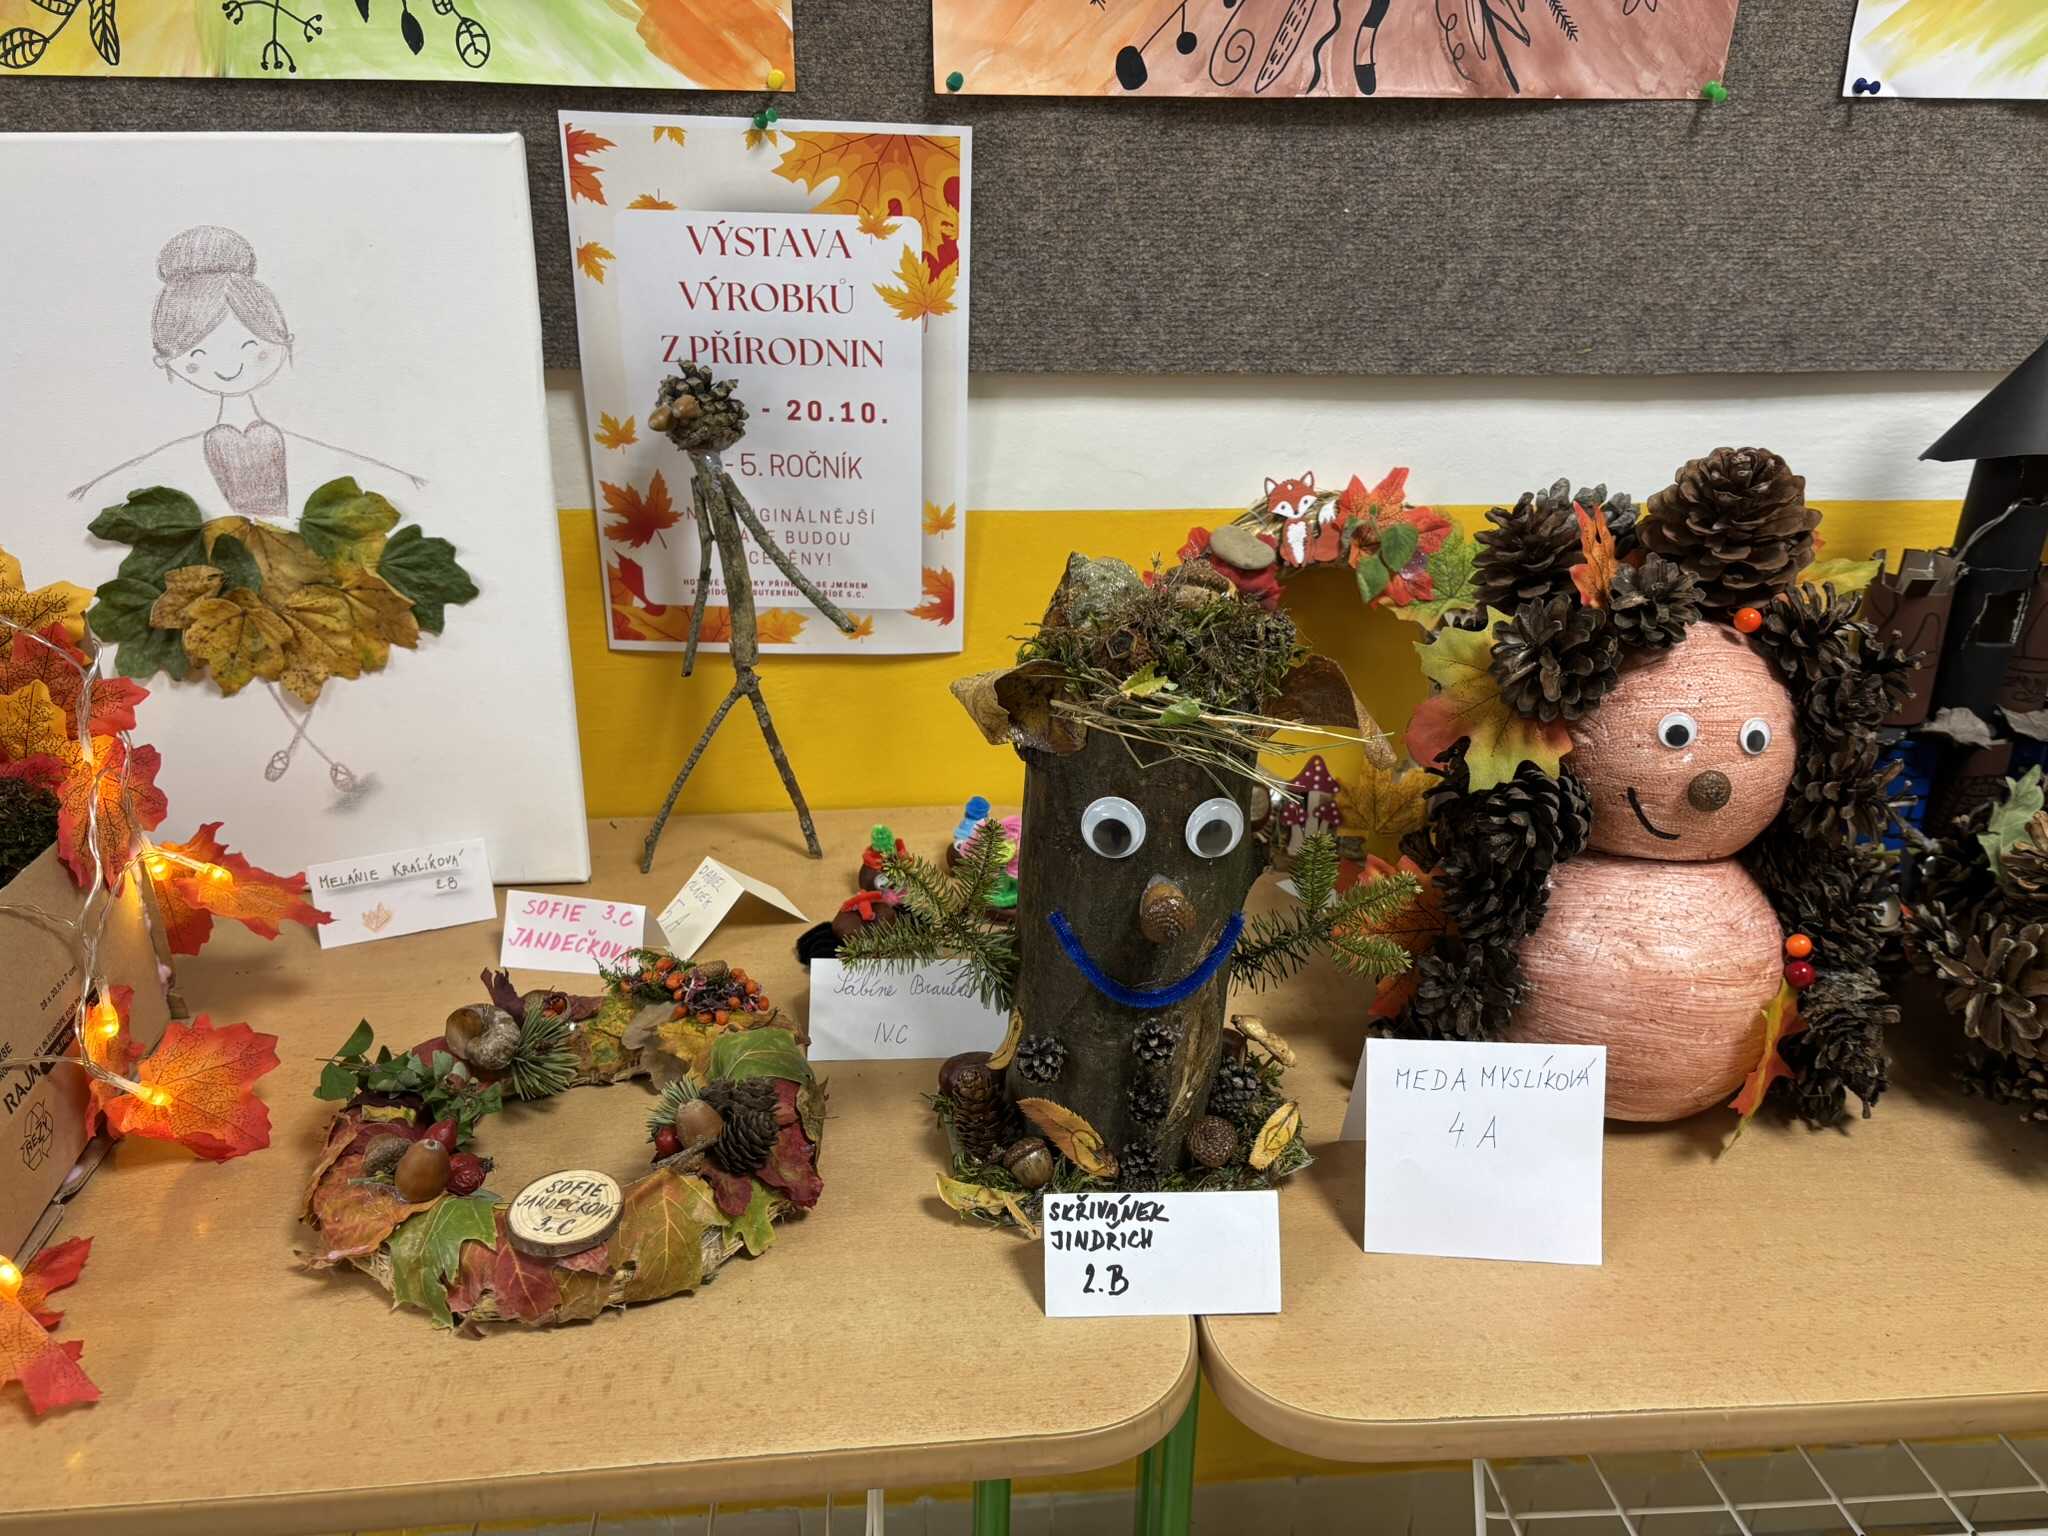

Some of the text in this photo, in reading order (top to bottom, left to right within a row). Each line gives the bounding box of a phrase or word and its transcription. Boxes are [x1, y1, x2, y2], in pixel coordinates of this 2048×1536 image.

[686, 220, 852, 259] VÝSTAVA
[678, 276, 854, 314] VÝROBKŮ
[661, 330, 884, 368] Z PŘÍRODNIN
[786, 399, 888, 424] 20.10.
[740, 453, 763, 477] 5.
[770, 451, 863, 479] ROČNÍK
[785, 530, 850, 546] BUDOU
[831, 580, 868, 589] JMÉNEM
[522, 899, 634, 928] SOFIE 3.C
[1395, 1055, 1597, 1092] MEDA MYSLÍKOVÁ
[3, 1063, 41, 1115] RAJA
[545, 1179, 608, 1197] SOFIE
[1049, 1194, 1170, 1223] SKŘIVÁNEK
[1051, 1220, 1154, 1252] JINDŘICH
[1082, 1263, 1130, 1296] 2.B
